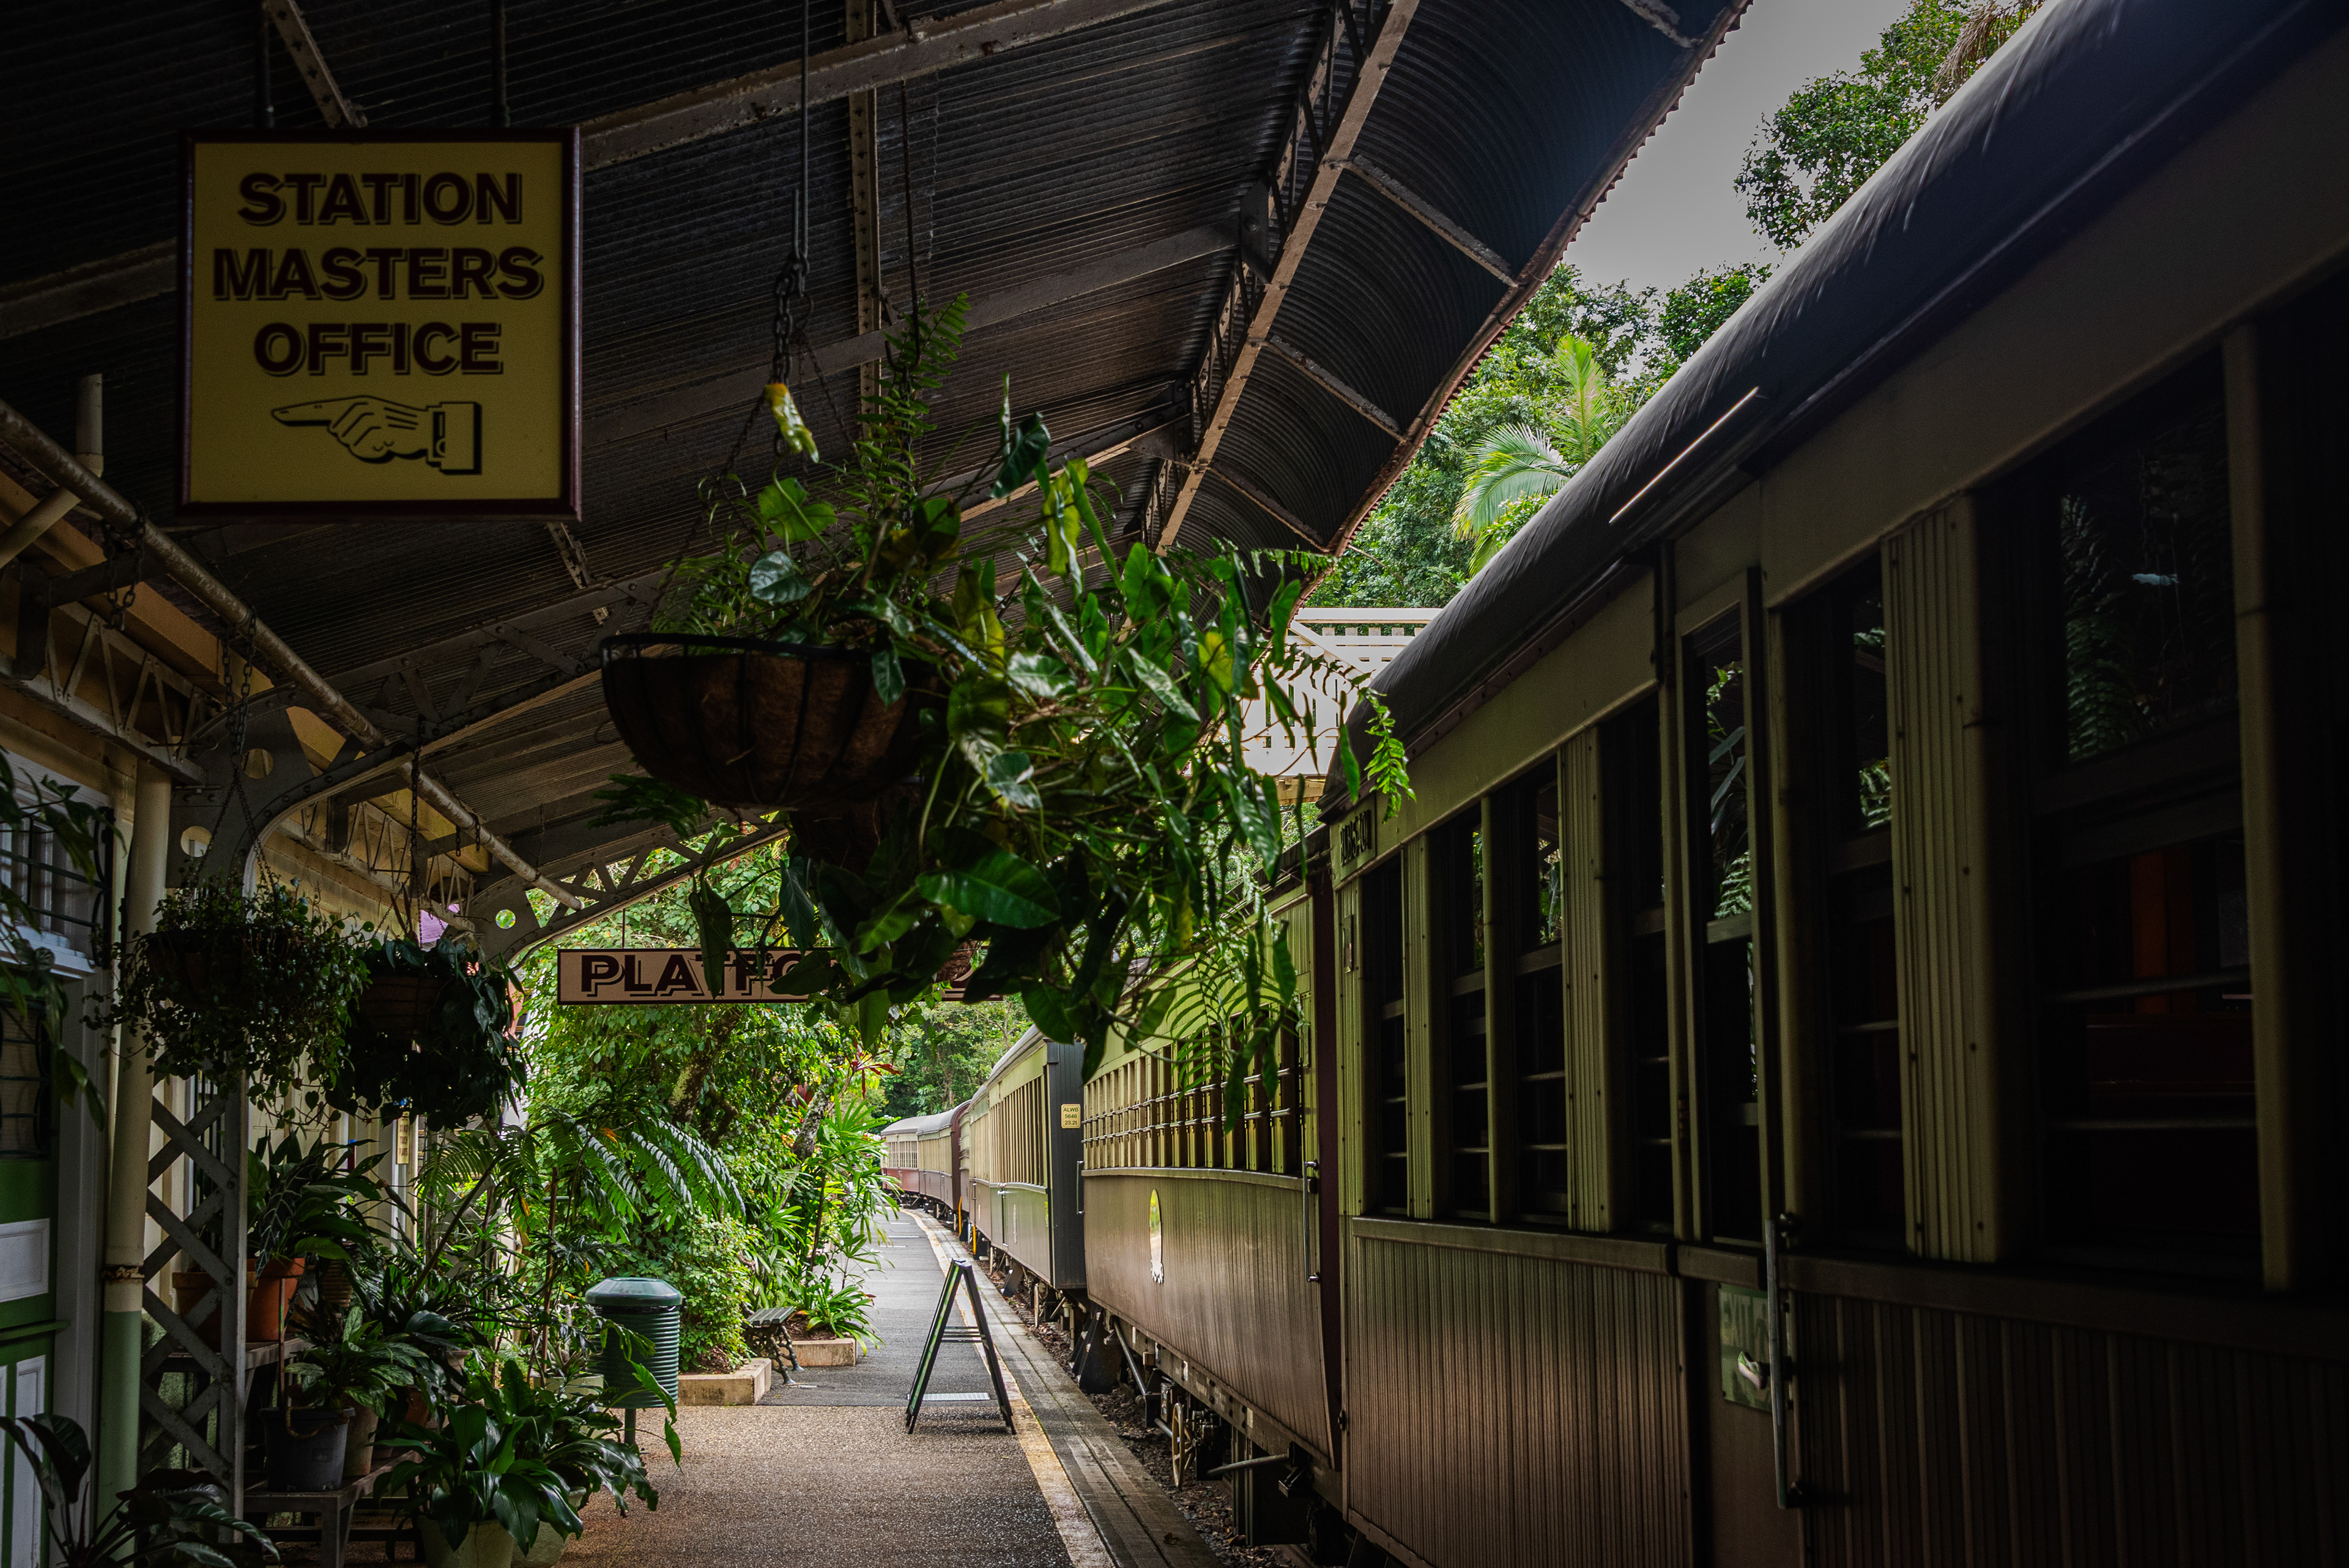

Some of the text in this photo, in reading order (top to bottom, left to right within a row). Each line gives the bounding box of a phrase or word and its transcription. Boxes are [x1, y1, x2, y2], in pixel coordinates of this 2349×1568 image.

[237, 172, 522, 226] STATION
[212, 246, 544, 301] MASTERS
[253, 321, 503, 376] OFFICE
